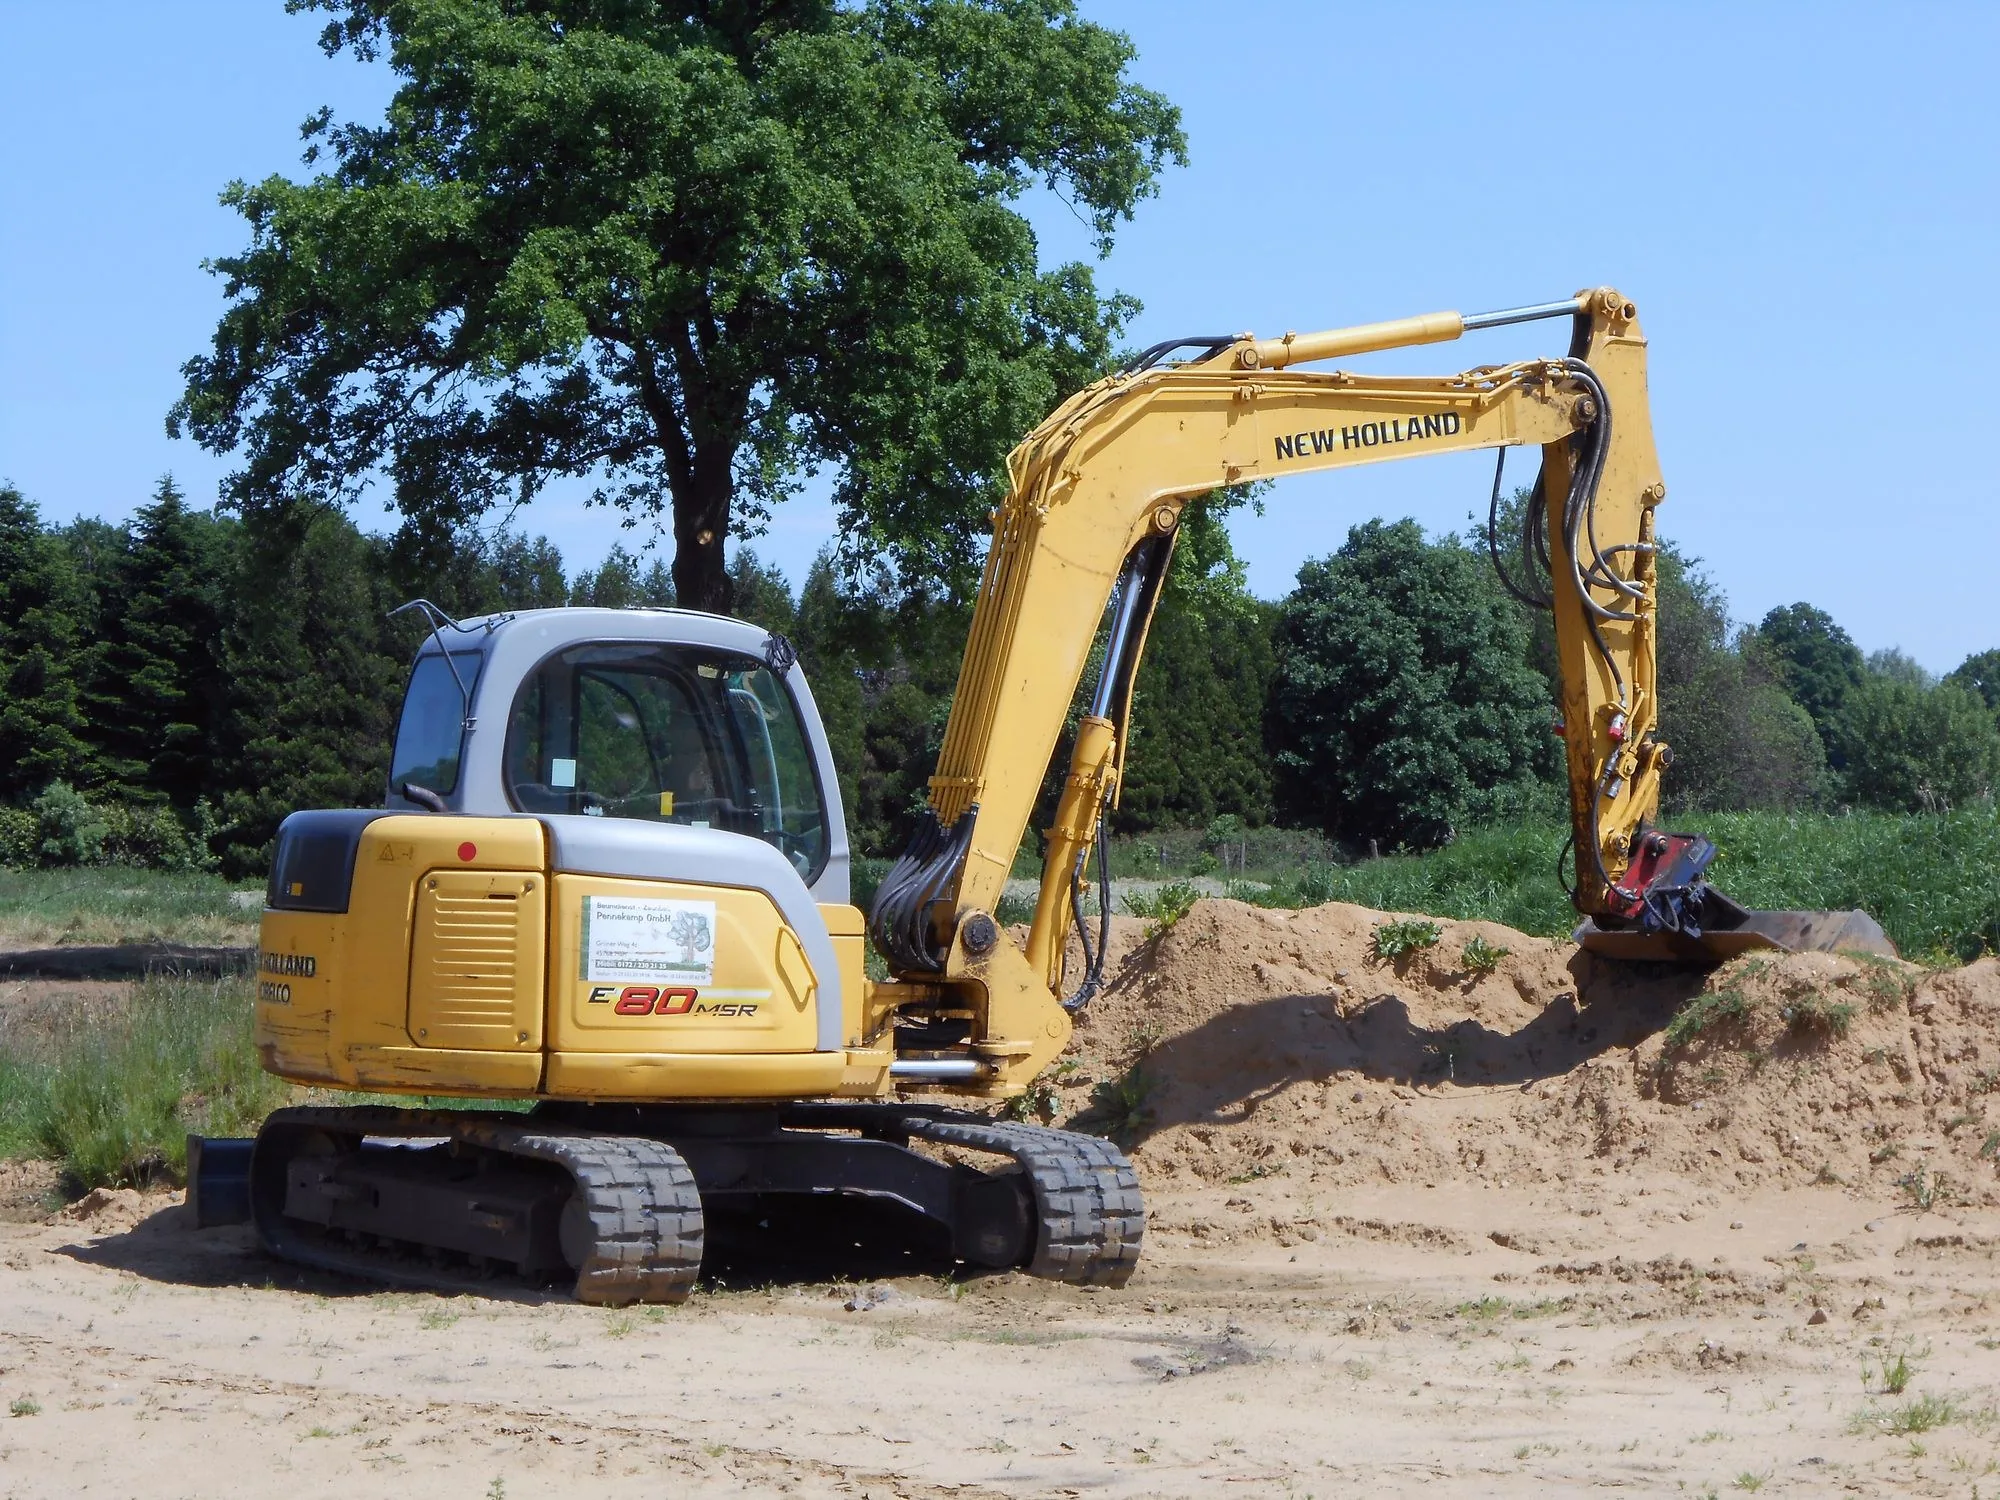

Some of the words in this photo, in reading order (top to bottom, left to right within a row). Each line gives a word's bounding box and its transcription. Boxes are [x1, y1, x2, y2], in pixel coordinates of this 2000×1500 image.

[1275, 429, 1334, 460] NEW
[1341, 412, 1460, 449] HOLLAND
[646, 914, 671, 922] GmbH
[695, 1003, 759, 1017] MSR
